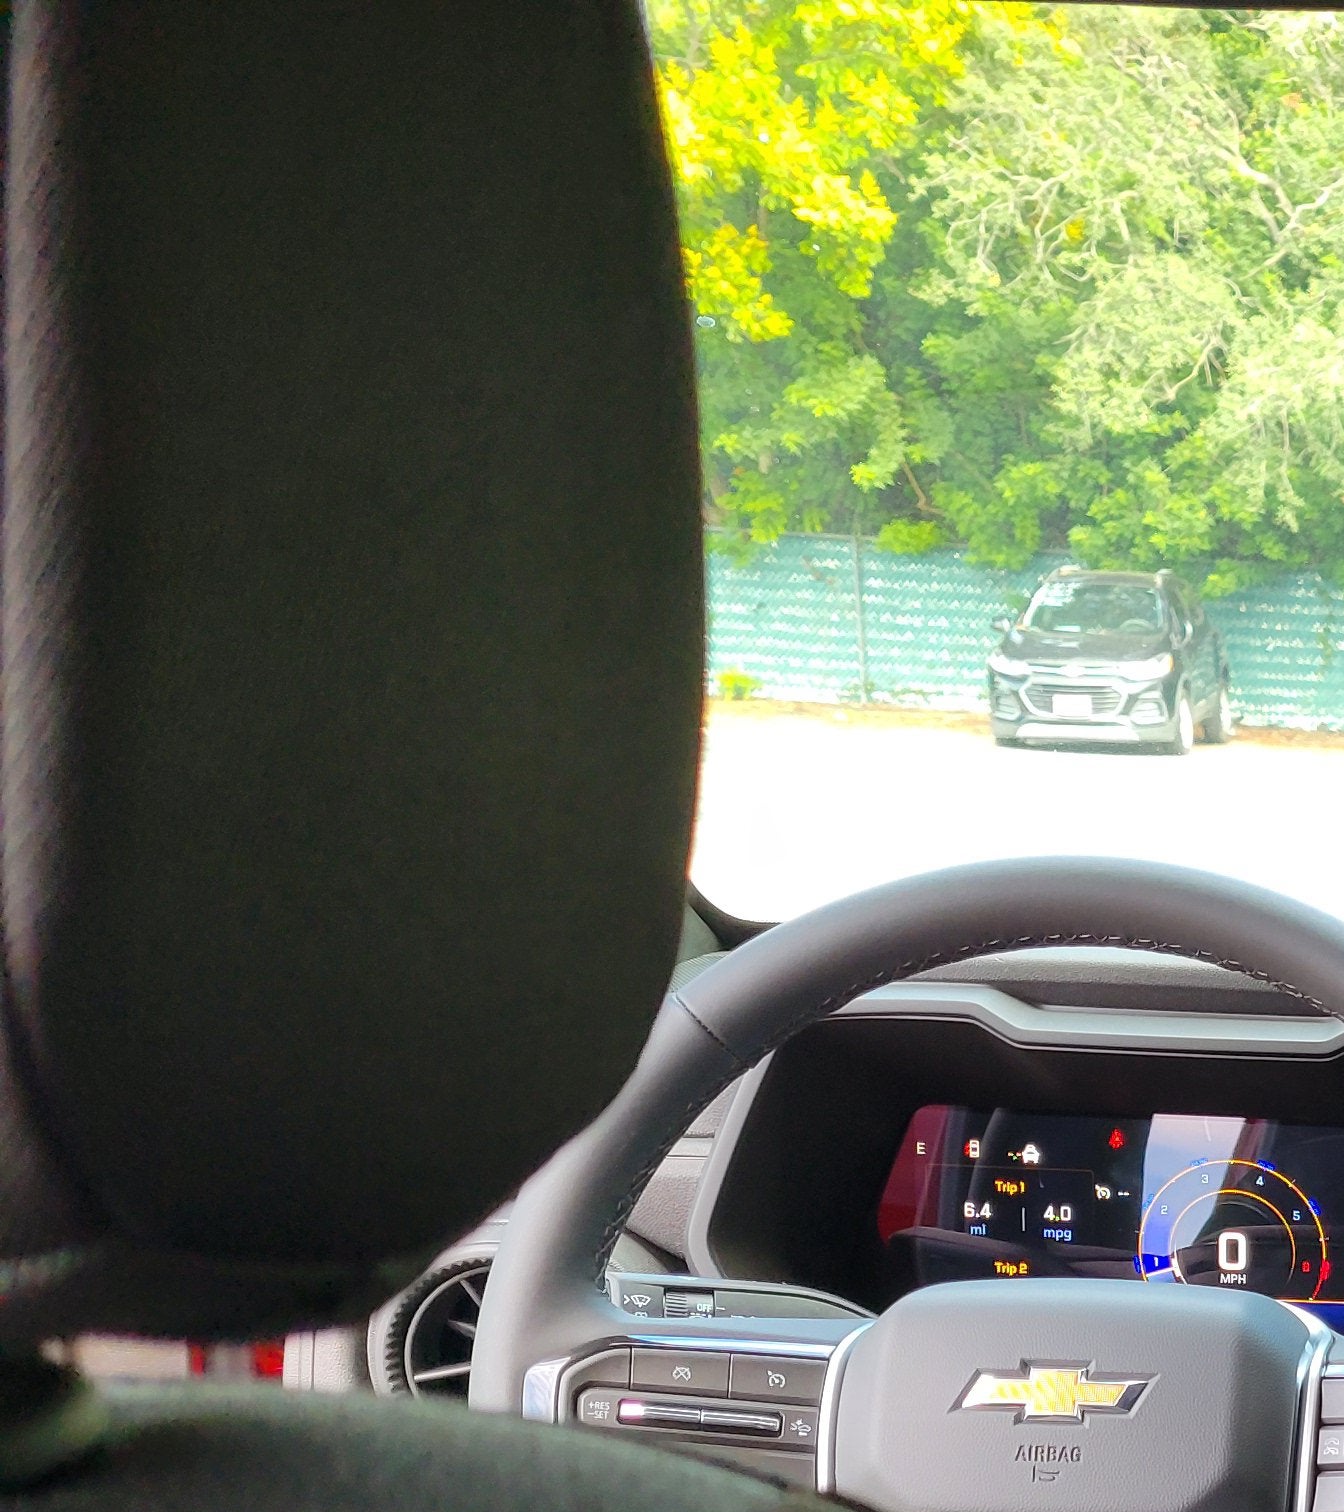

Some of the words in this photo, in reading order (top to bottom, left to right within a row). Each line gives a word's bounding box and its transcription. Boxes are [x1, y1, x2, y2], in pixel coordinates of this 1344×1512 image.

[916, 1142, 926, 1155] E
[1201, 1174, 1209, 1184] 3
[1256, 1176, 1264, 1186] 4
[994, 1180, 1018, 1195] Trip
[1020, 1181, 1026, 1193] 1
[963, 1202, 992, 1219] 6.4
[1043, 1205, 1072, 1221] 4.0
[1160, 1205, 1168, 1215] 2
[1292, 1211, 1300, 1220] 5
[970, 1223, 987, 1235] mi
[1043, 1228, 1072, 1241] mpg
[1218, 1231, 1247, 1271] 0
[1154, 1257, 1159, 1267] 1
[994, 1261, 1017, 1276] Trip
[1019, 1262, 1029, 1275] 2
[1220, 1274, 1247, 1284] MPH
[696, 1304, 713, 1312] OFF
[1015, 1445, 1081, 1463] AIRBAG
